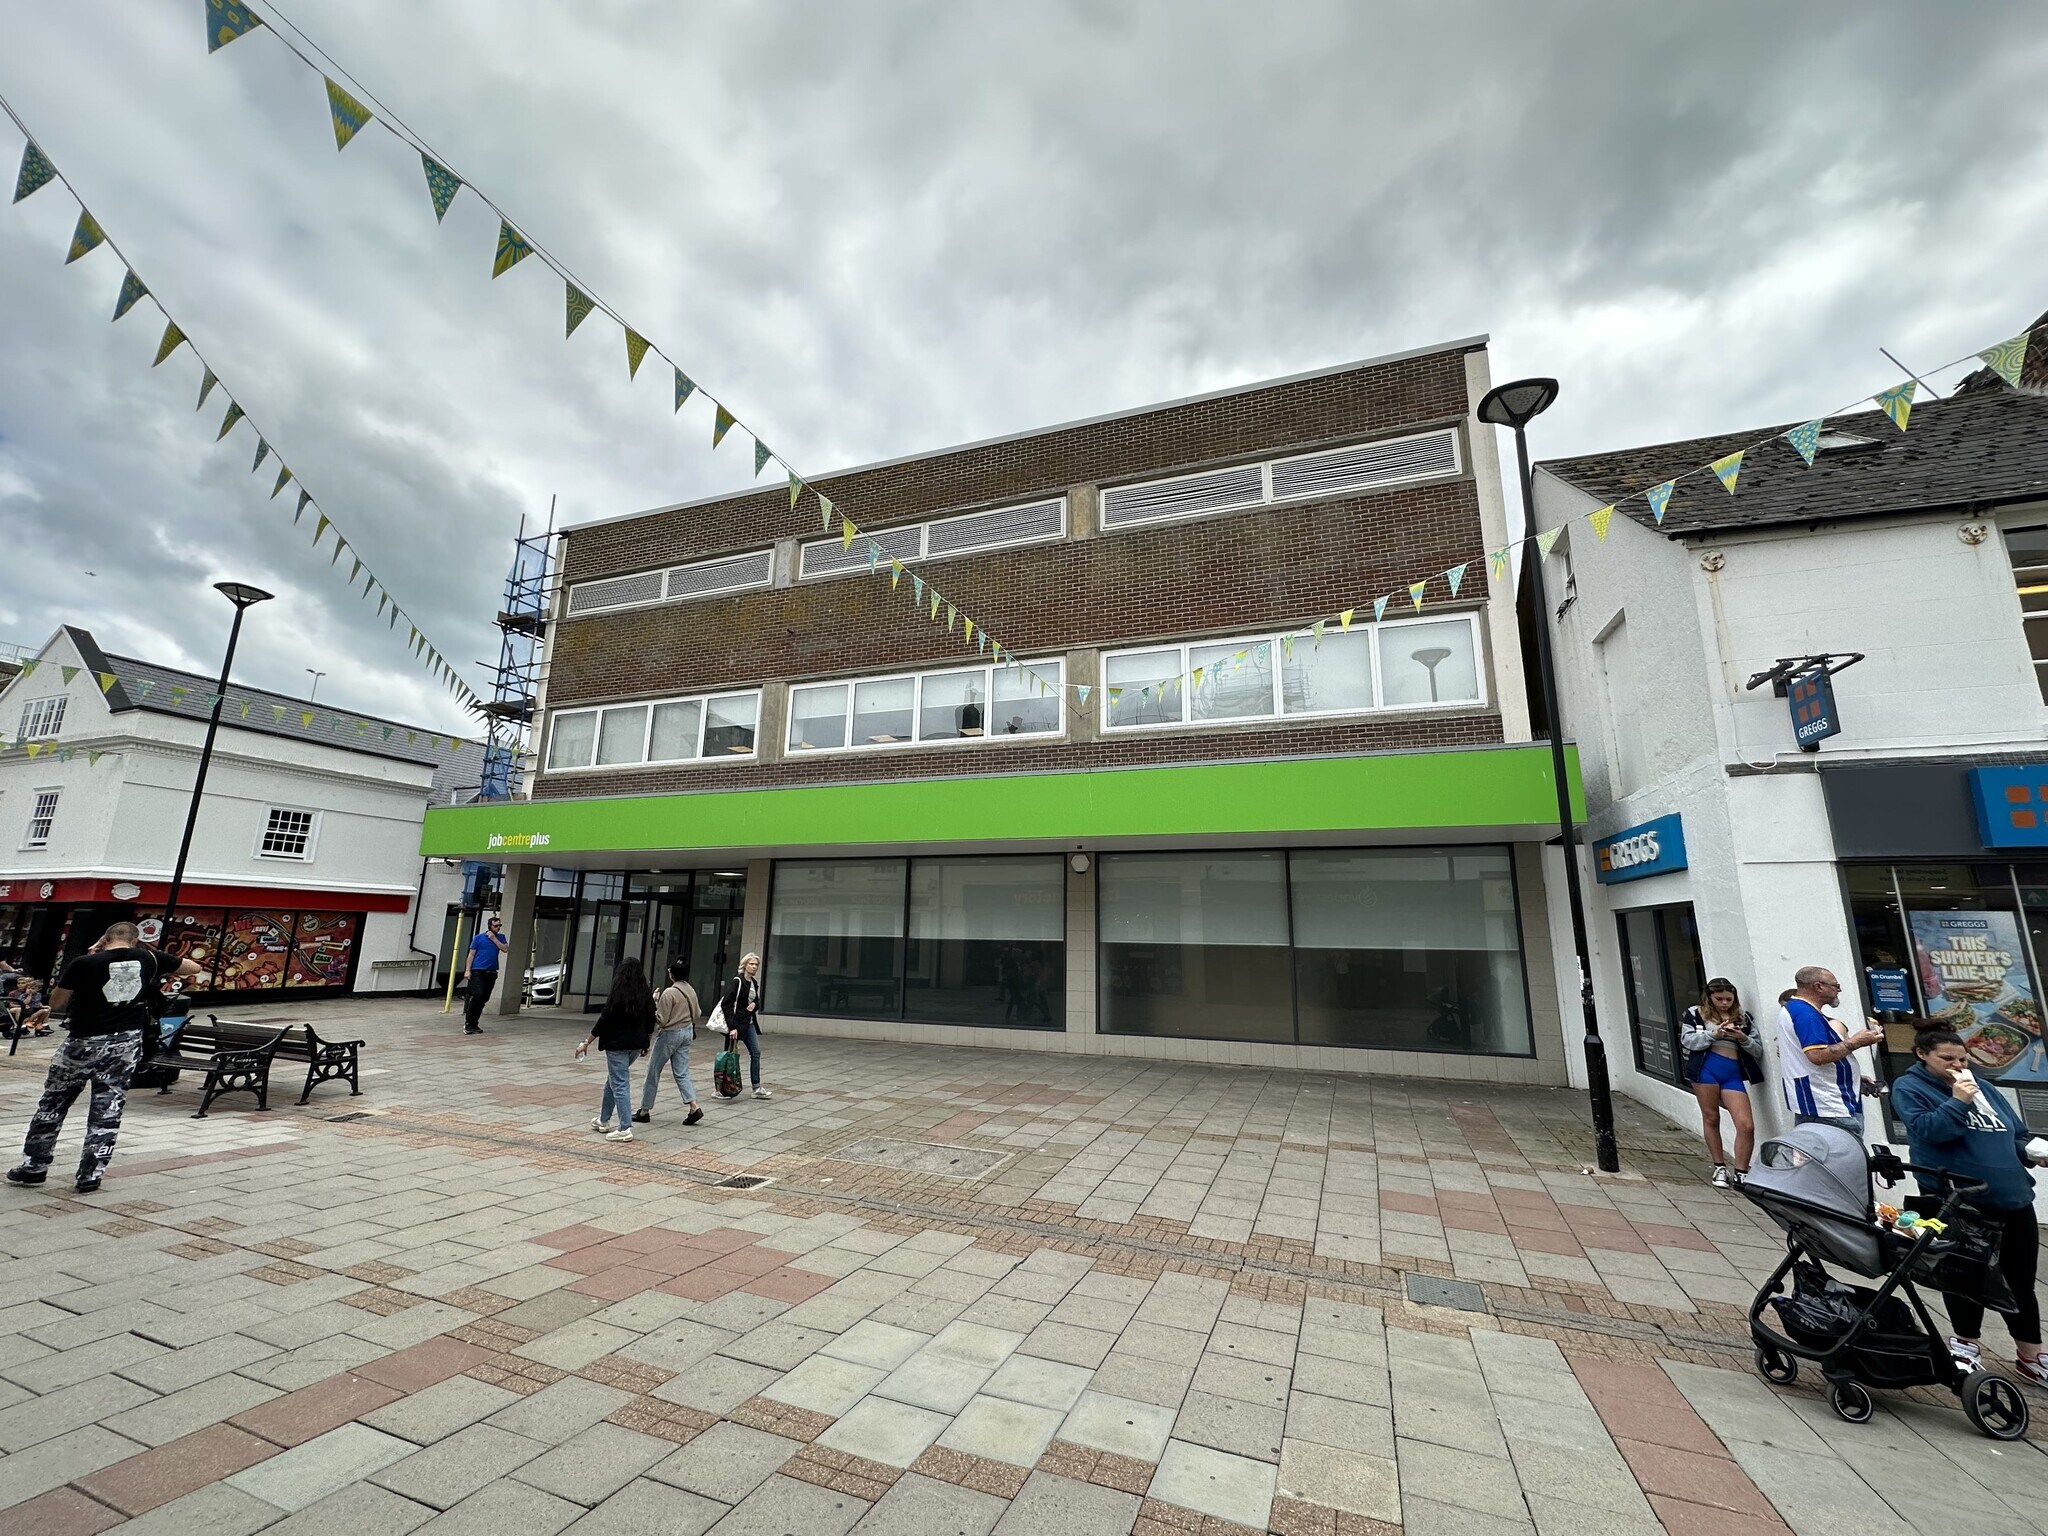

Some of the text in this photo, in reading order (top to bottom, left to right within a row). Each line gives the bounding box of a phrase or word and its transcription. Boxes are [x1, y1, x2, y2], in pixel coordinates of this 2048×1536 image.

[1798, 717, 1828, 739] GREGGS
[486, 831, 551, 850] jobcentreplus
[1609, 830, 1660, 870] GREGGS
[1947, 936, 1987, 951] THIS
[1930, 950, 2013, 967] SUMMER'S
[1941, 965, 2006, 981] LINE-UP
[1966, 1111, 2006, 1129] ALK
